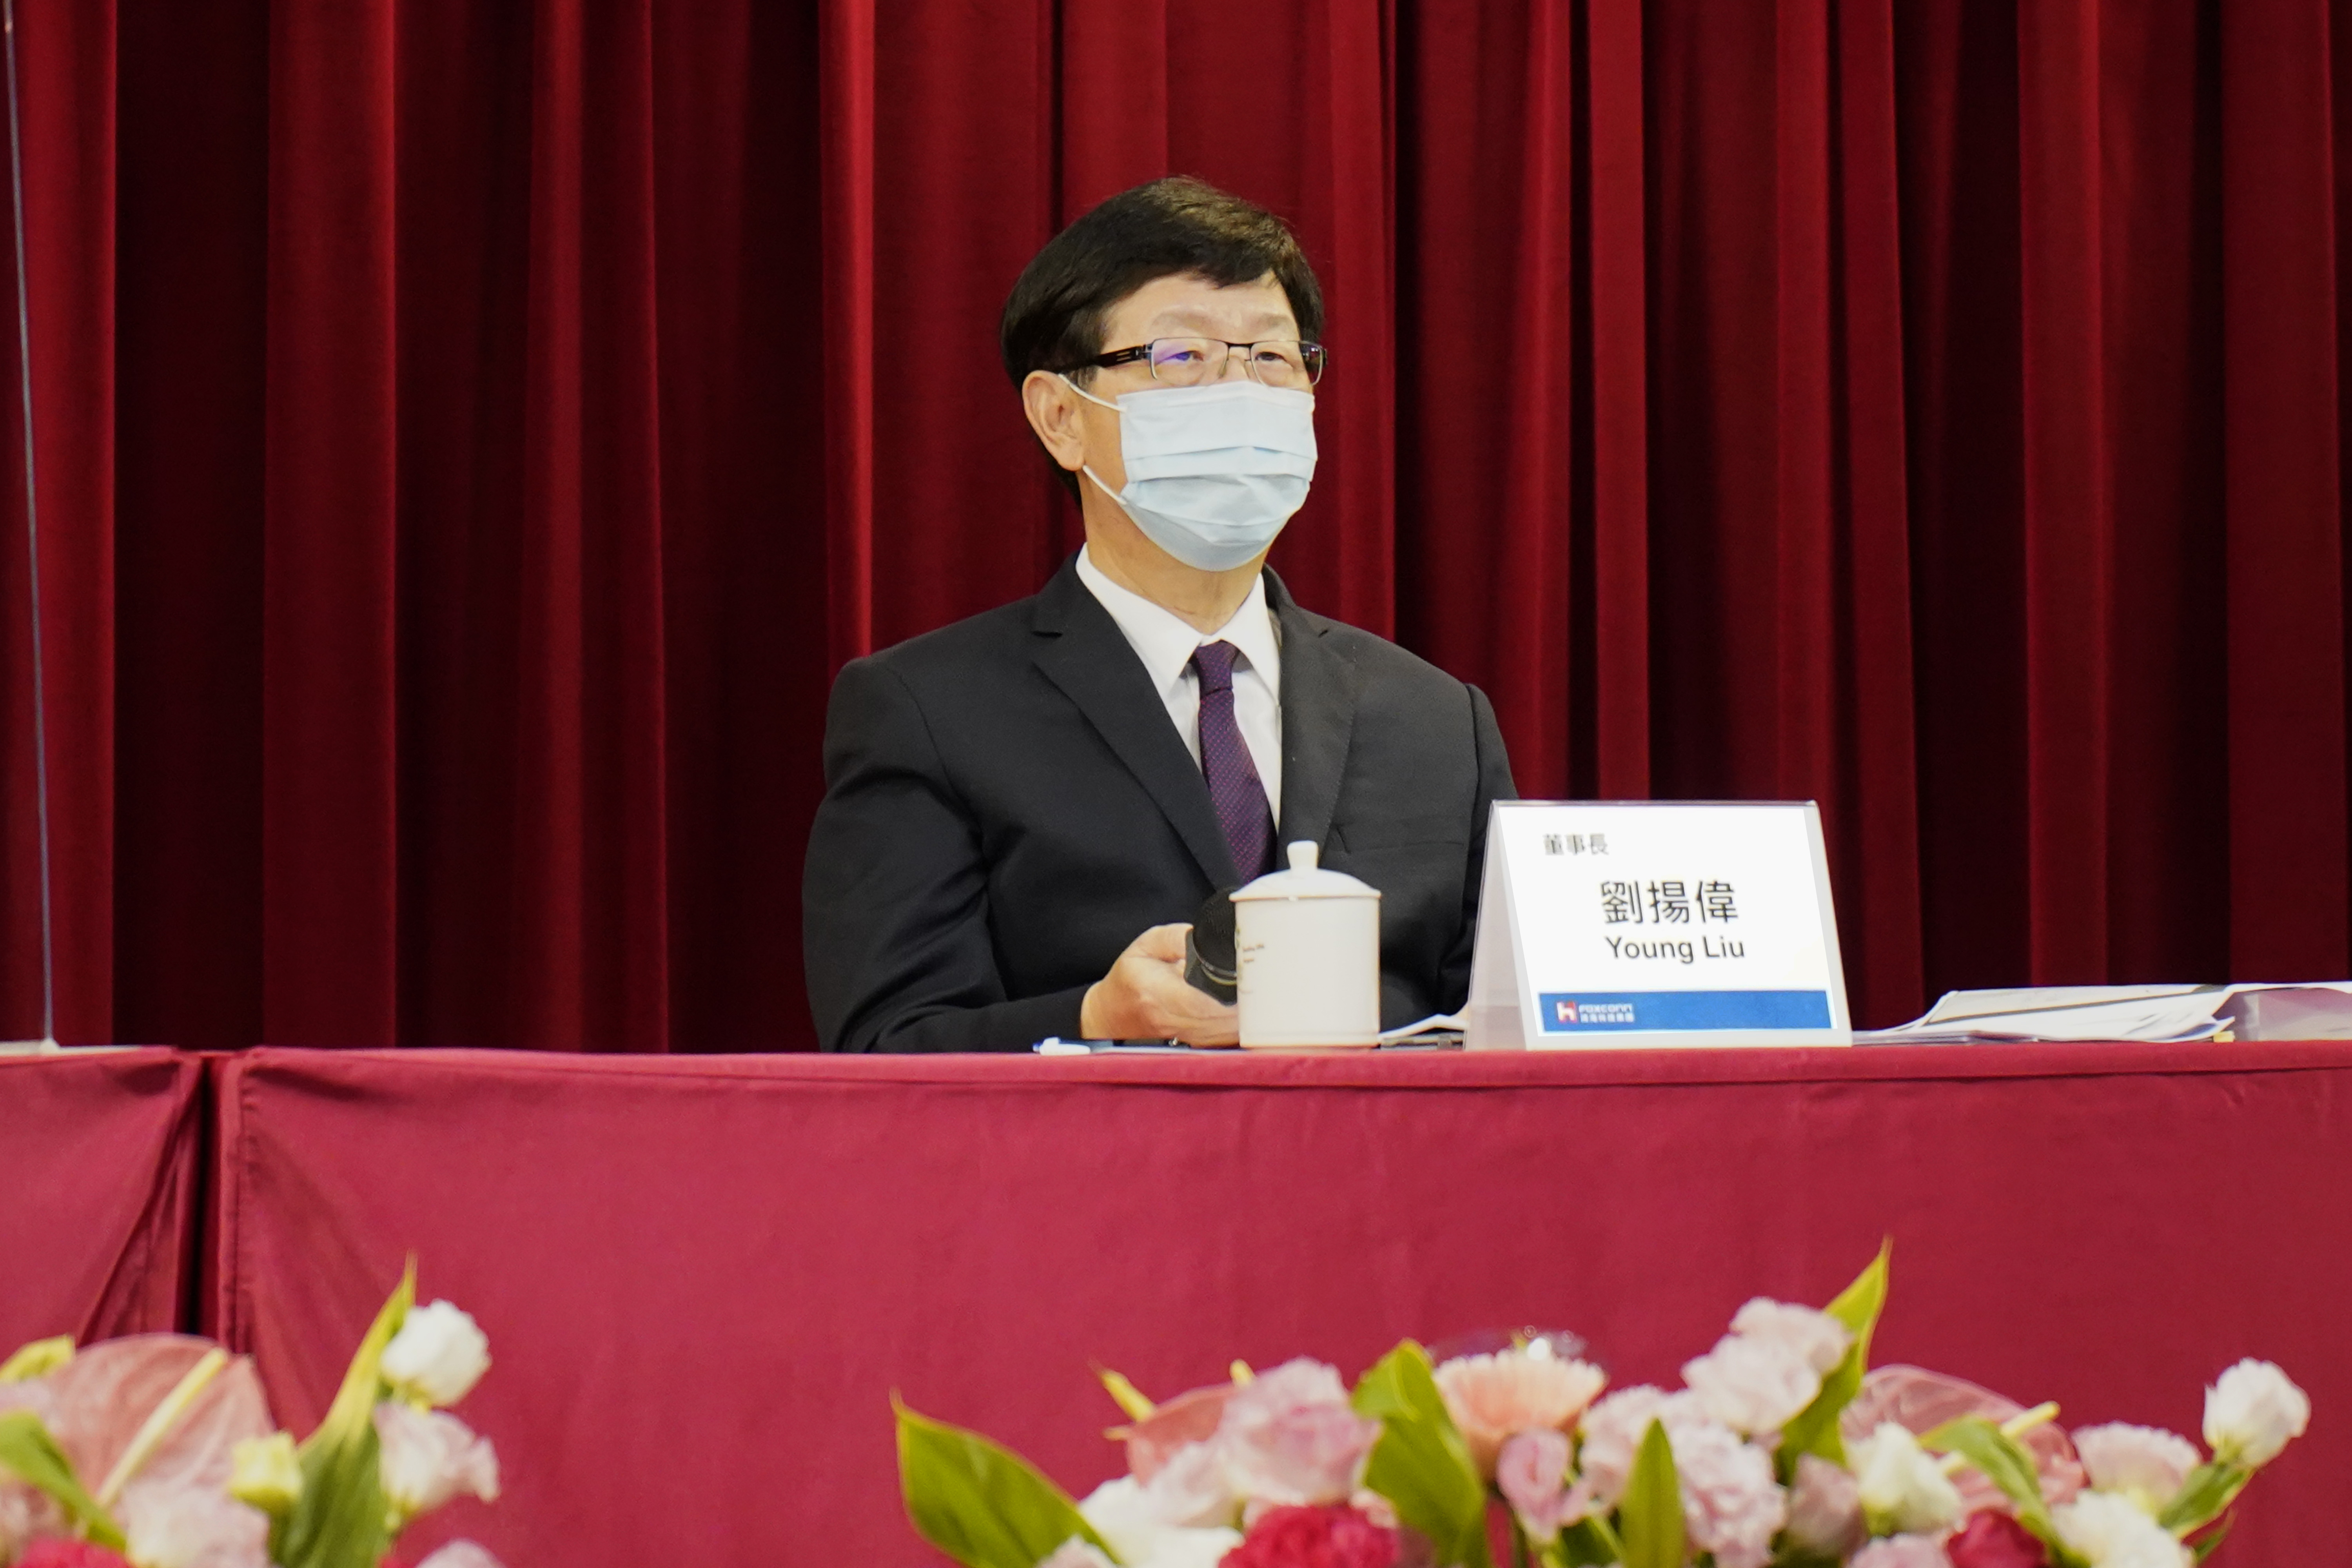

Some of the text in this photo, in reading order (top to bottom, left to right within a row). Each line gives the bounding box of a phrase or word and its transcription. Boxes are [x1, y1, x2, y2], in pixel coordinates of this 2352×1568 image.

[1601, 881, 1738, 923] 劉揚偉
[1606, 936, 1745, 964] Young Liu
